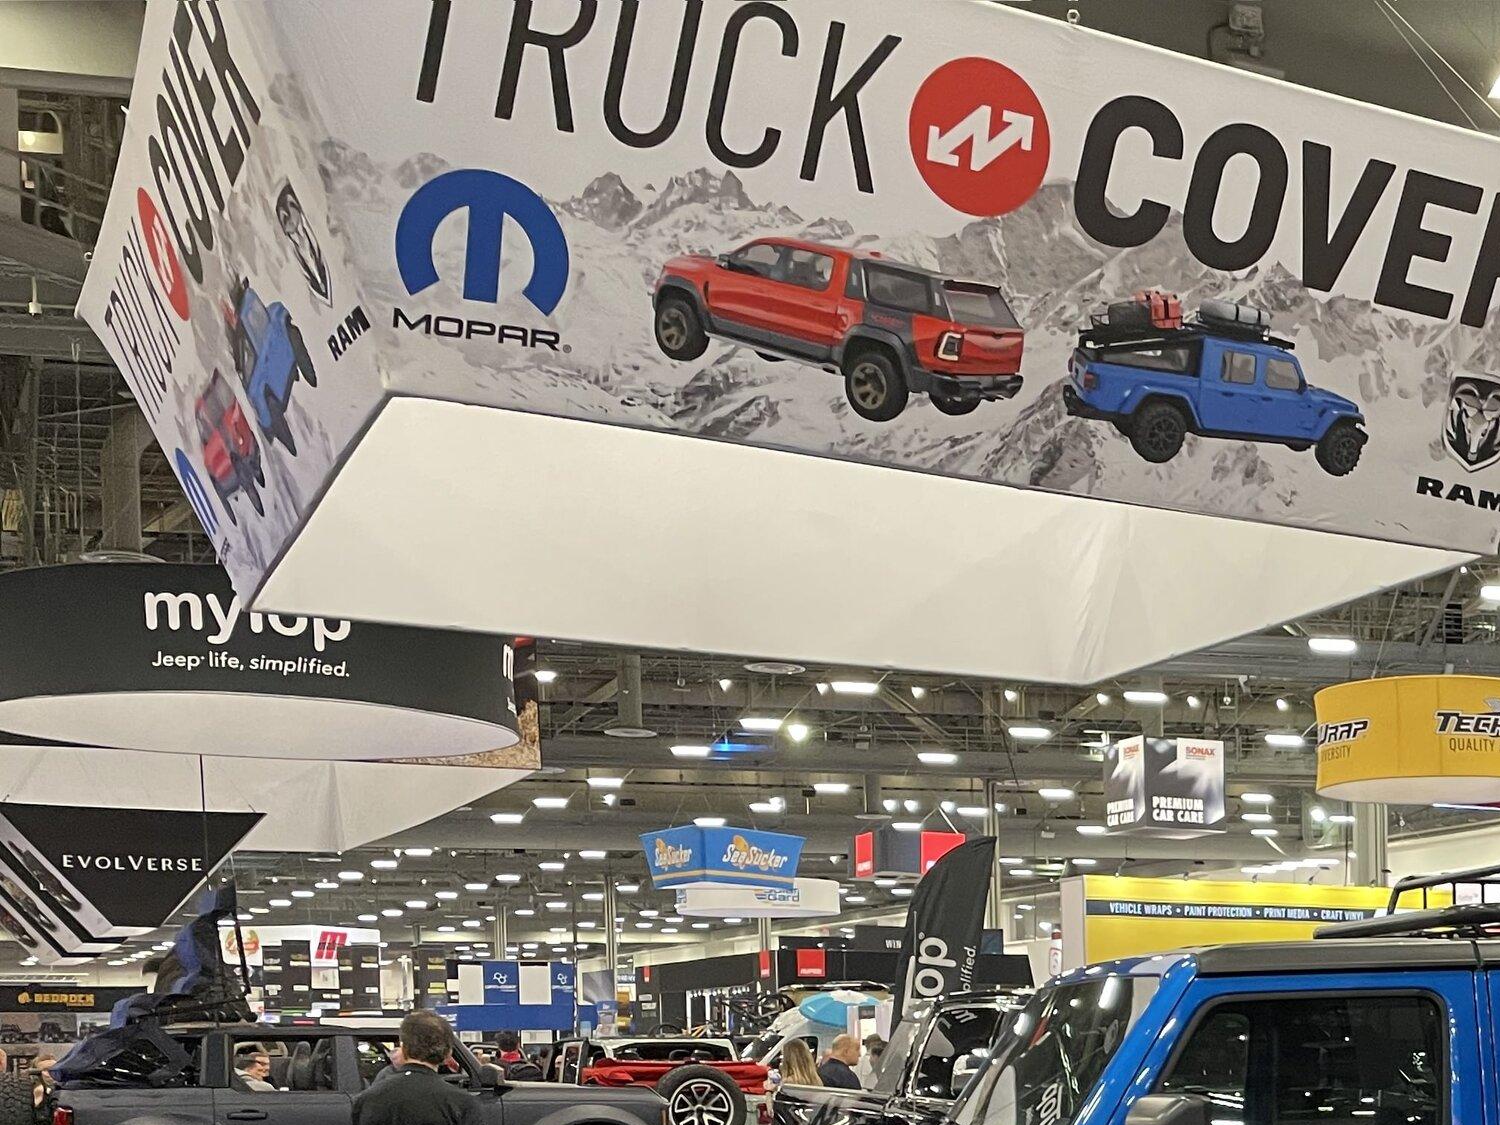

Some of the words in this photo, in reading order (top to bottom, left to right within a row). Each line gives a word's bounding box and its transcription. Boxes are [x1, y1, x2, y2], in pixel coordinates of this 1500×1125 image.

[149, 0, 260, 284] COVER
[327, 306, 371, 362] RAM
[152, 651, 204, 672] Jeep
[208, 650, 245, 672] life,
[249, 655, 350, 678] simplified.
[1186, 746, 1215, 756] SONAX
[1449, 738, 1495, 752] QUALITY
[1152, 796, 1204, 811] PREMIUM
[1152, 809, 1175, 822] CAR
[1177, 811, 1204, 824] CARE
[62, 854, 203, 871] EVOLVERSE
[722, 843, 788, 868] SeaSucker
[1109, 902, 1142, 914] VEHICLE
[1144, 904, 1173, 916] WRAPS
[1184, 905, 1206, 917] PAINT
[1208, 906, 1253, 918] PROTECTION
[1264, 908, 1286, 918] PRINT
[1287, 908, 1310, 919] MEDIA
[1321, 909, 1343, 920] CRAFT
[34, 993, 95, 1004] BEDROCK
